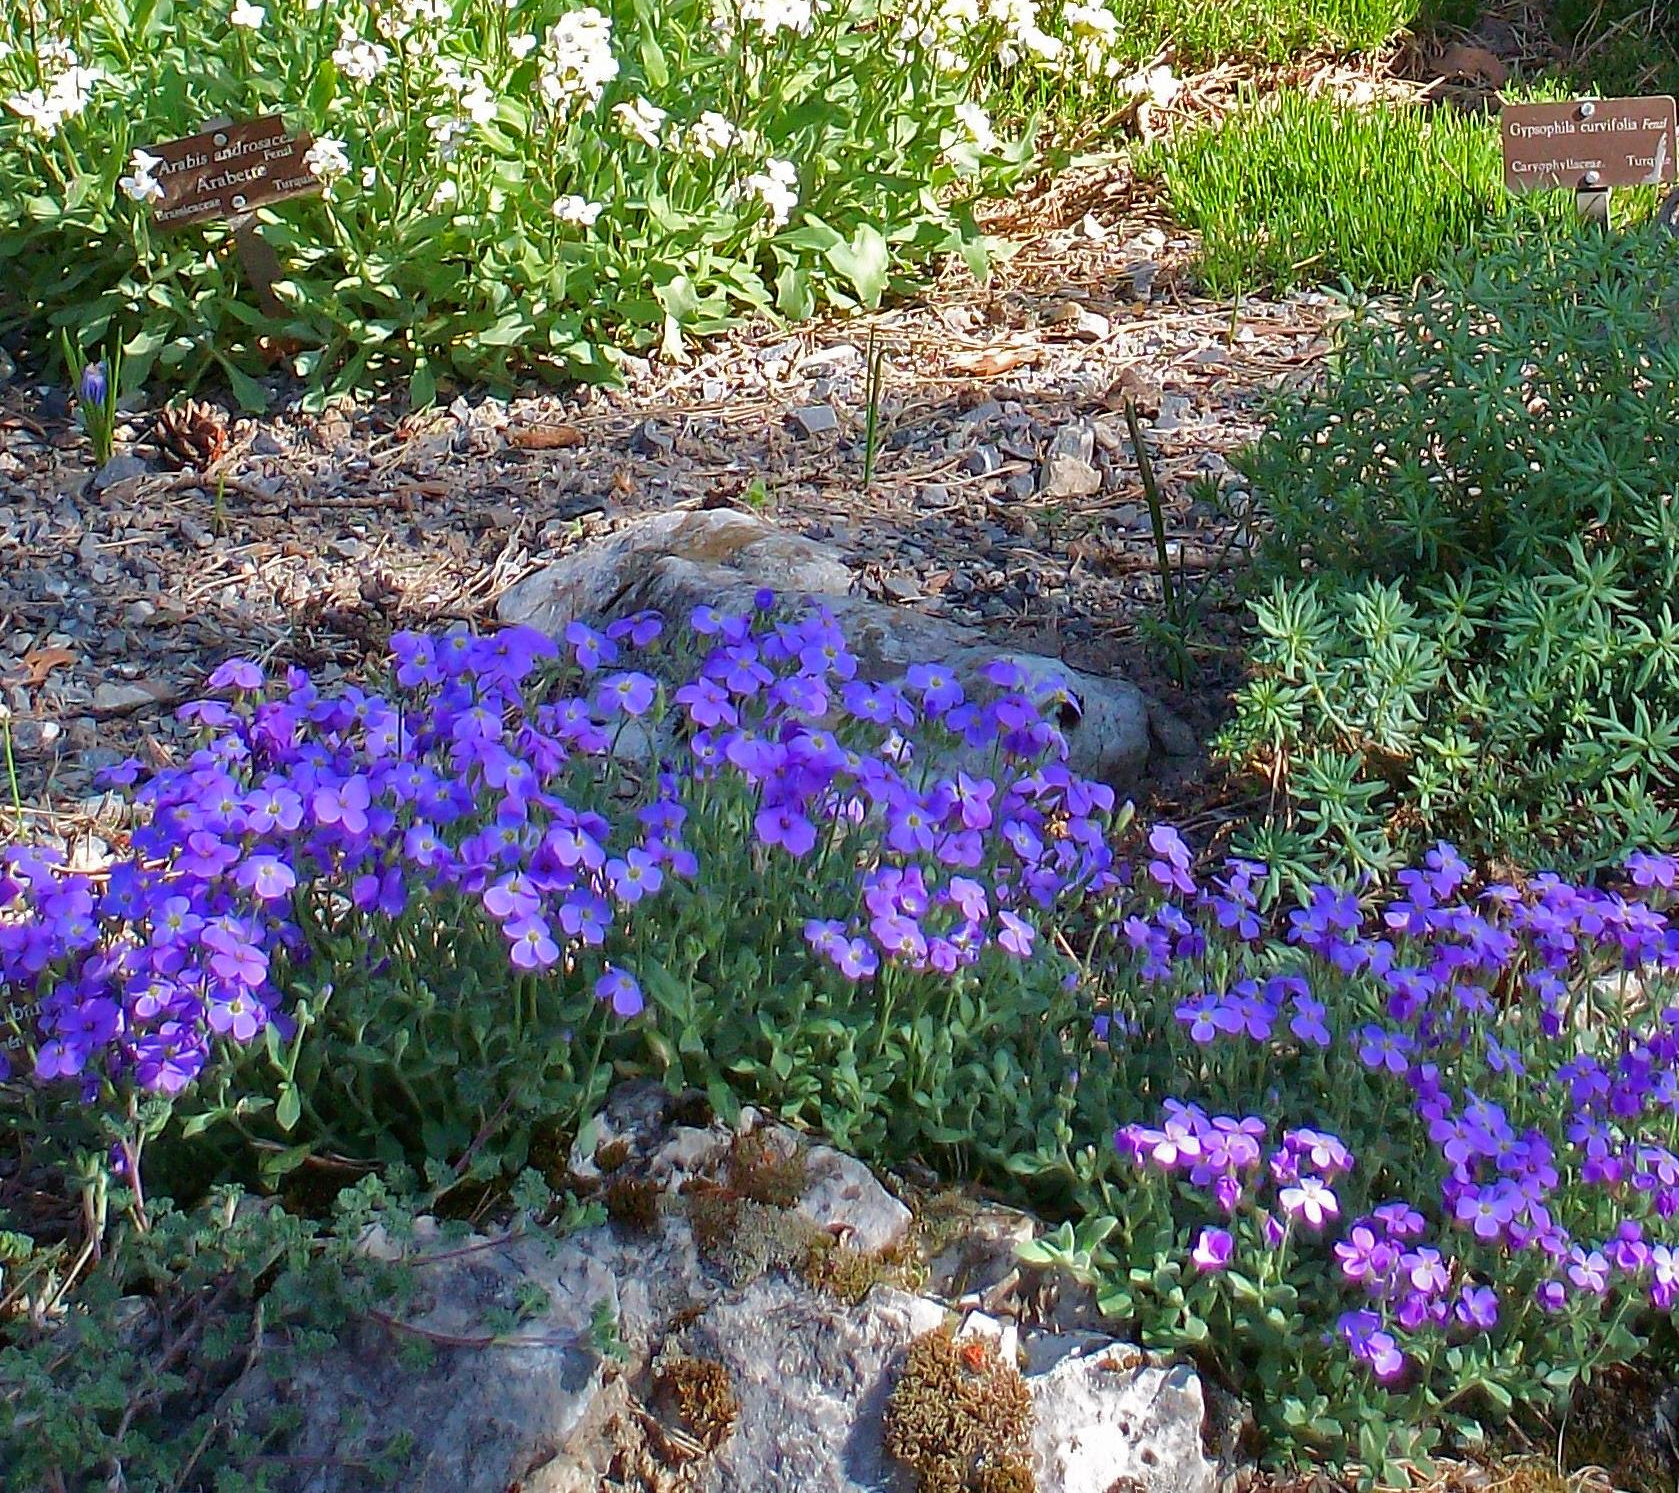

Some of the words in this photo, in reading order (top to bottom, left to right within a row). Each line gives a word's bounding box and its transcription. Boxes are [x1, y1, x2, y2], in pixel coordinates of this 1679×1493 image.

[1509, 120, 1575, 138] Gypsophila
[1580, 117, 1638, 133] curvifolia
[158, 152, 209, 177] Arabis
[213, 133, 295, 162] androsace
[1626, 154, 1672, 168] Turqe
[196, 164, 268, 194] Arabette
